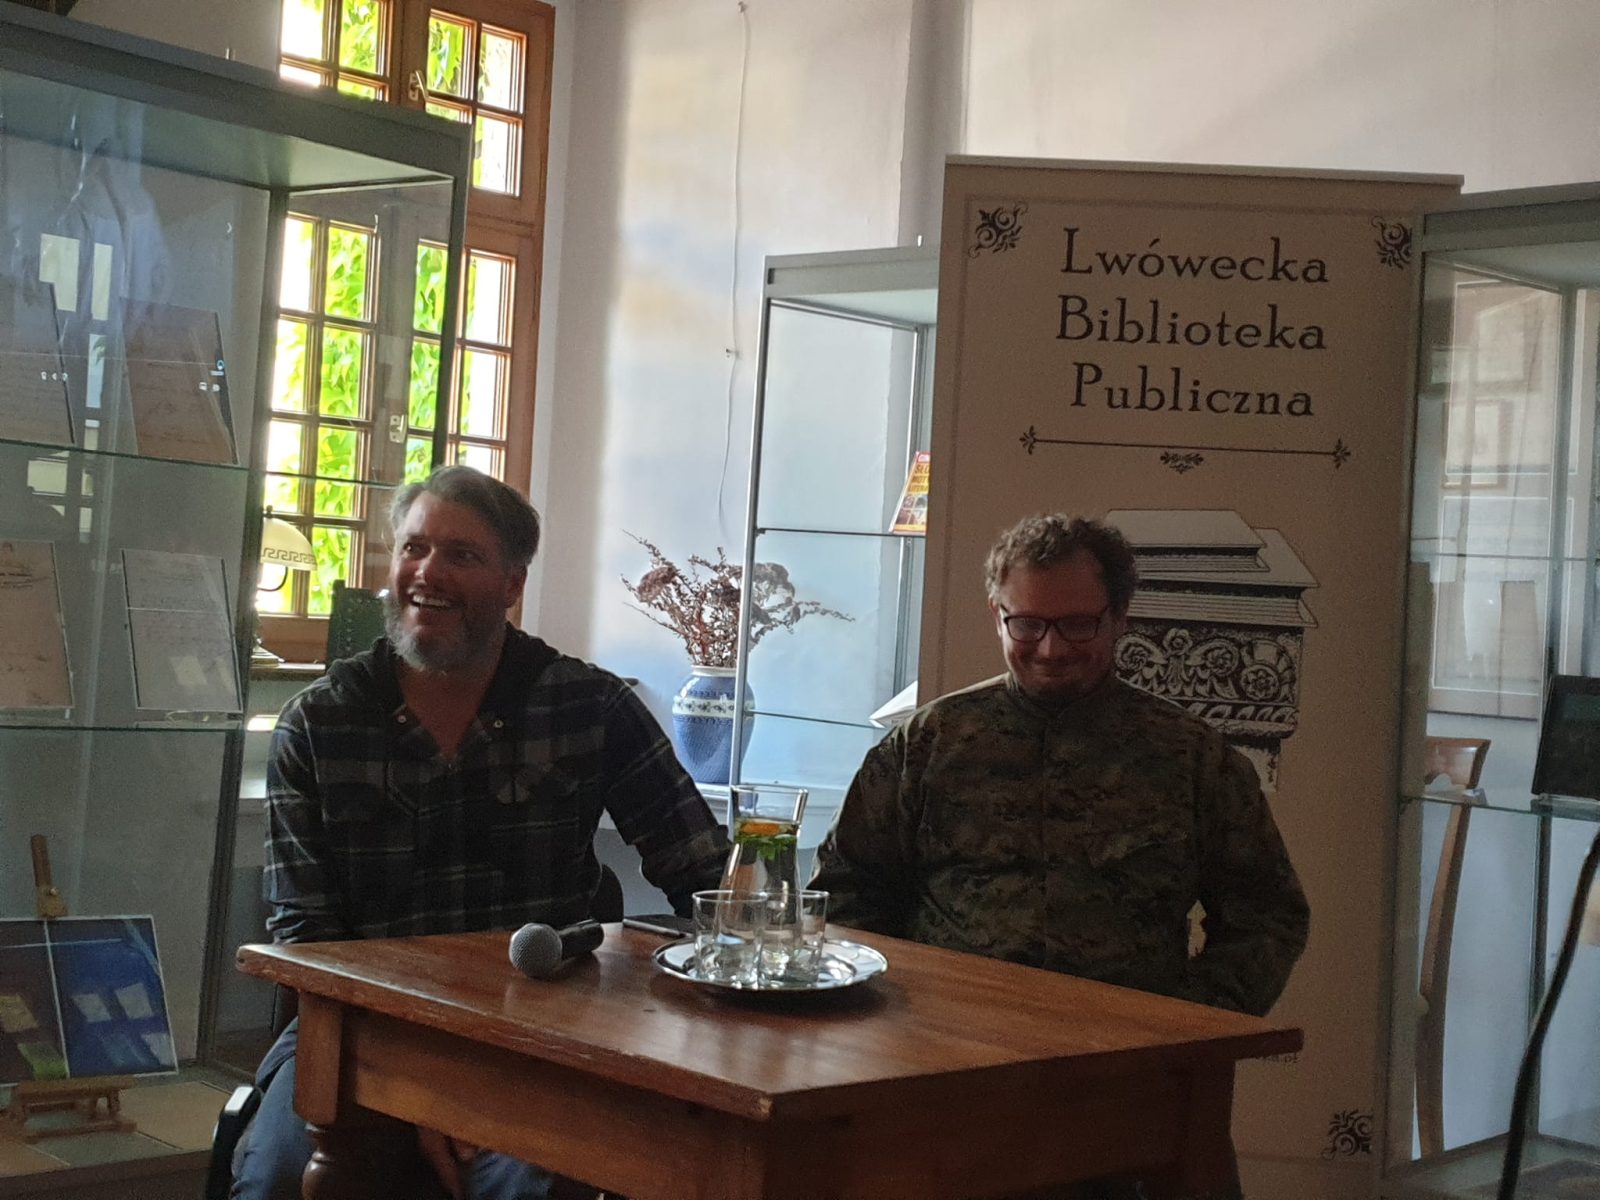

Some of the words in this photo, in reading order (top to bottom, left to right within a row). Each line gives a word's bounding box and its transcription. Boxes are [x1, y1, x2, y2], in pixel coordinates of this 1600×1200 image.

[1061, 227, 1329, 284] Lwówecka
[1056, 294, 1327, 351] Biblioteka
[1070, 361, 1314, 417] Publiczna
